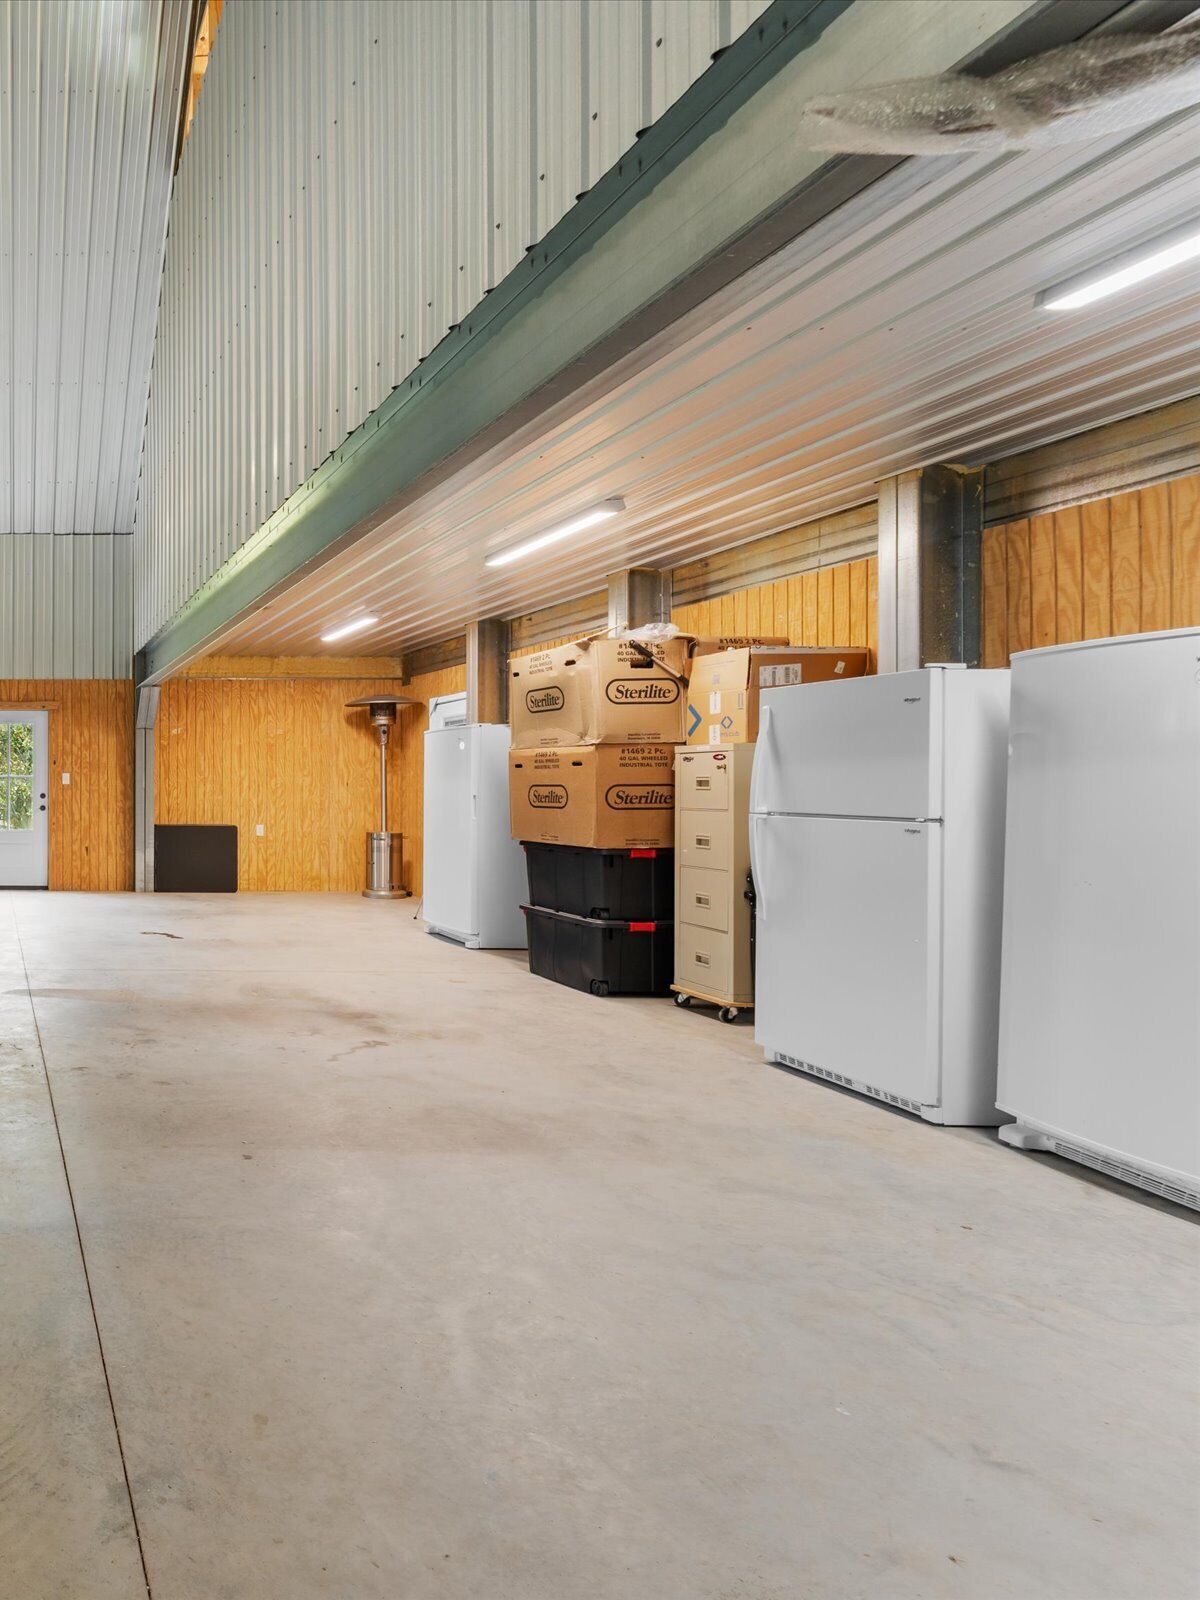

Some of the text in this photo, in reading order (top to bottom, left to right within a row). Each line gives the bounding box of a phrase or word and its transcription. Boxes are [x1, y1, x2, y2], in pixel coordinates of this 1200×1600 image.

[615, 684, 671, 699] Sterilite
[530, 692, 559, 709] Sterilite
[533, 789, 563, 804] Sterilite
[615, 789, 672, 805] Sterilite
